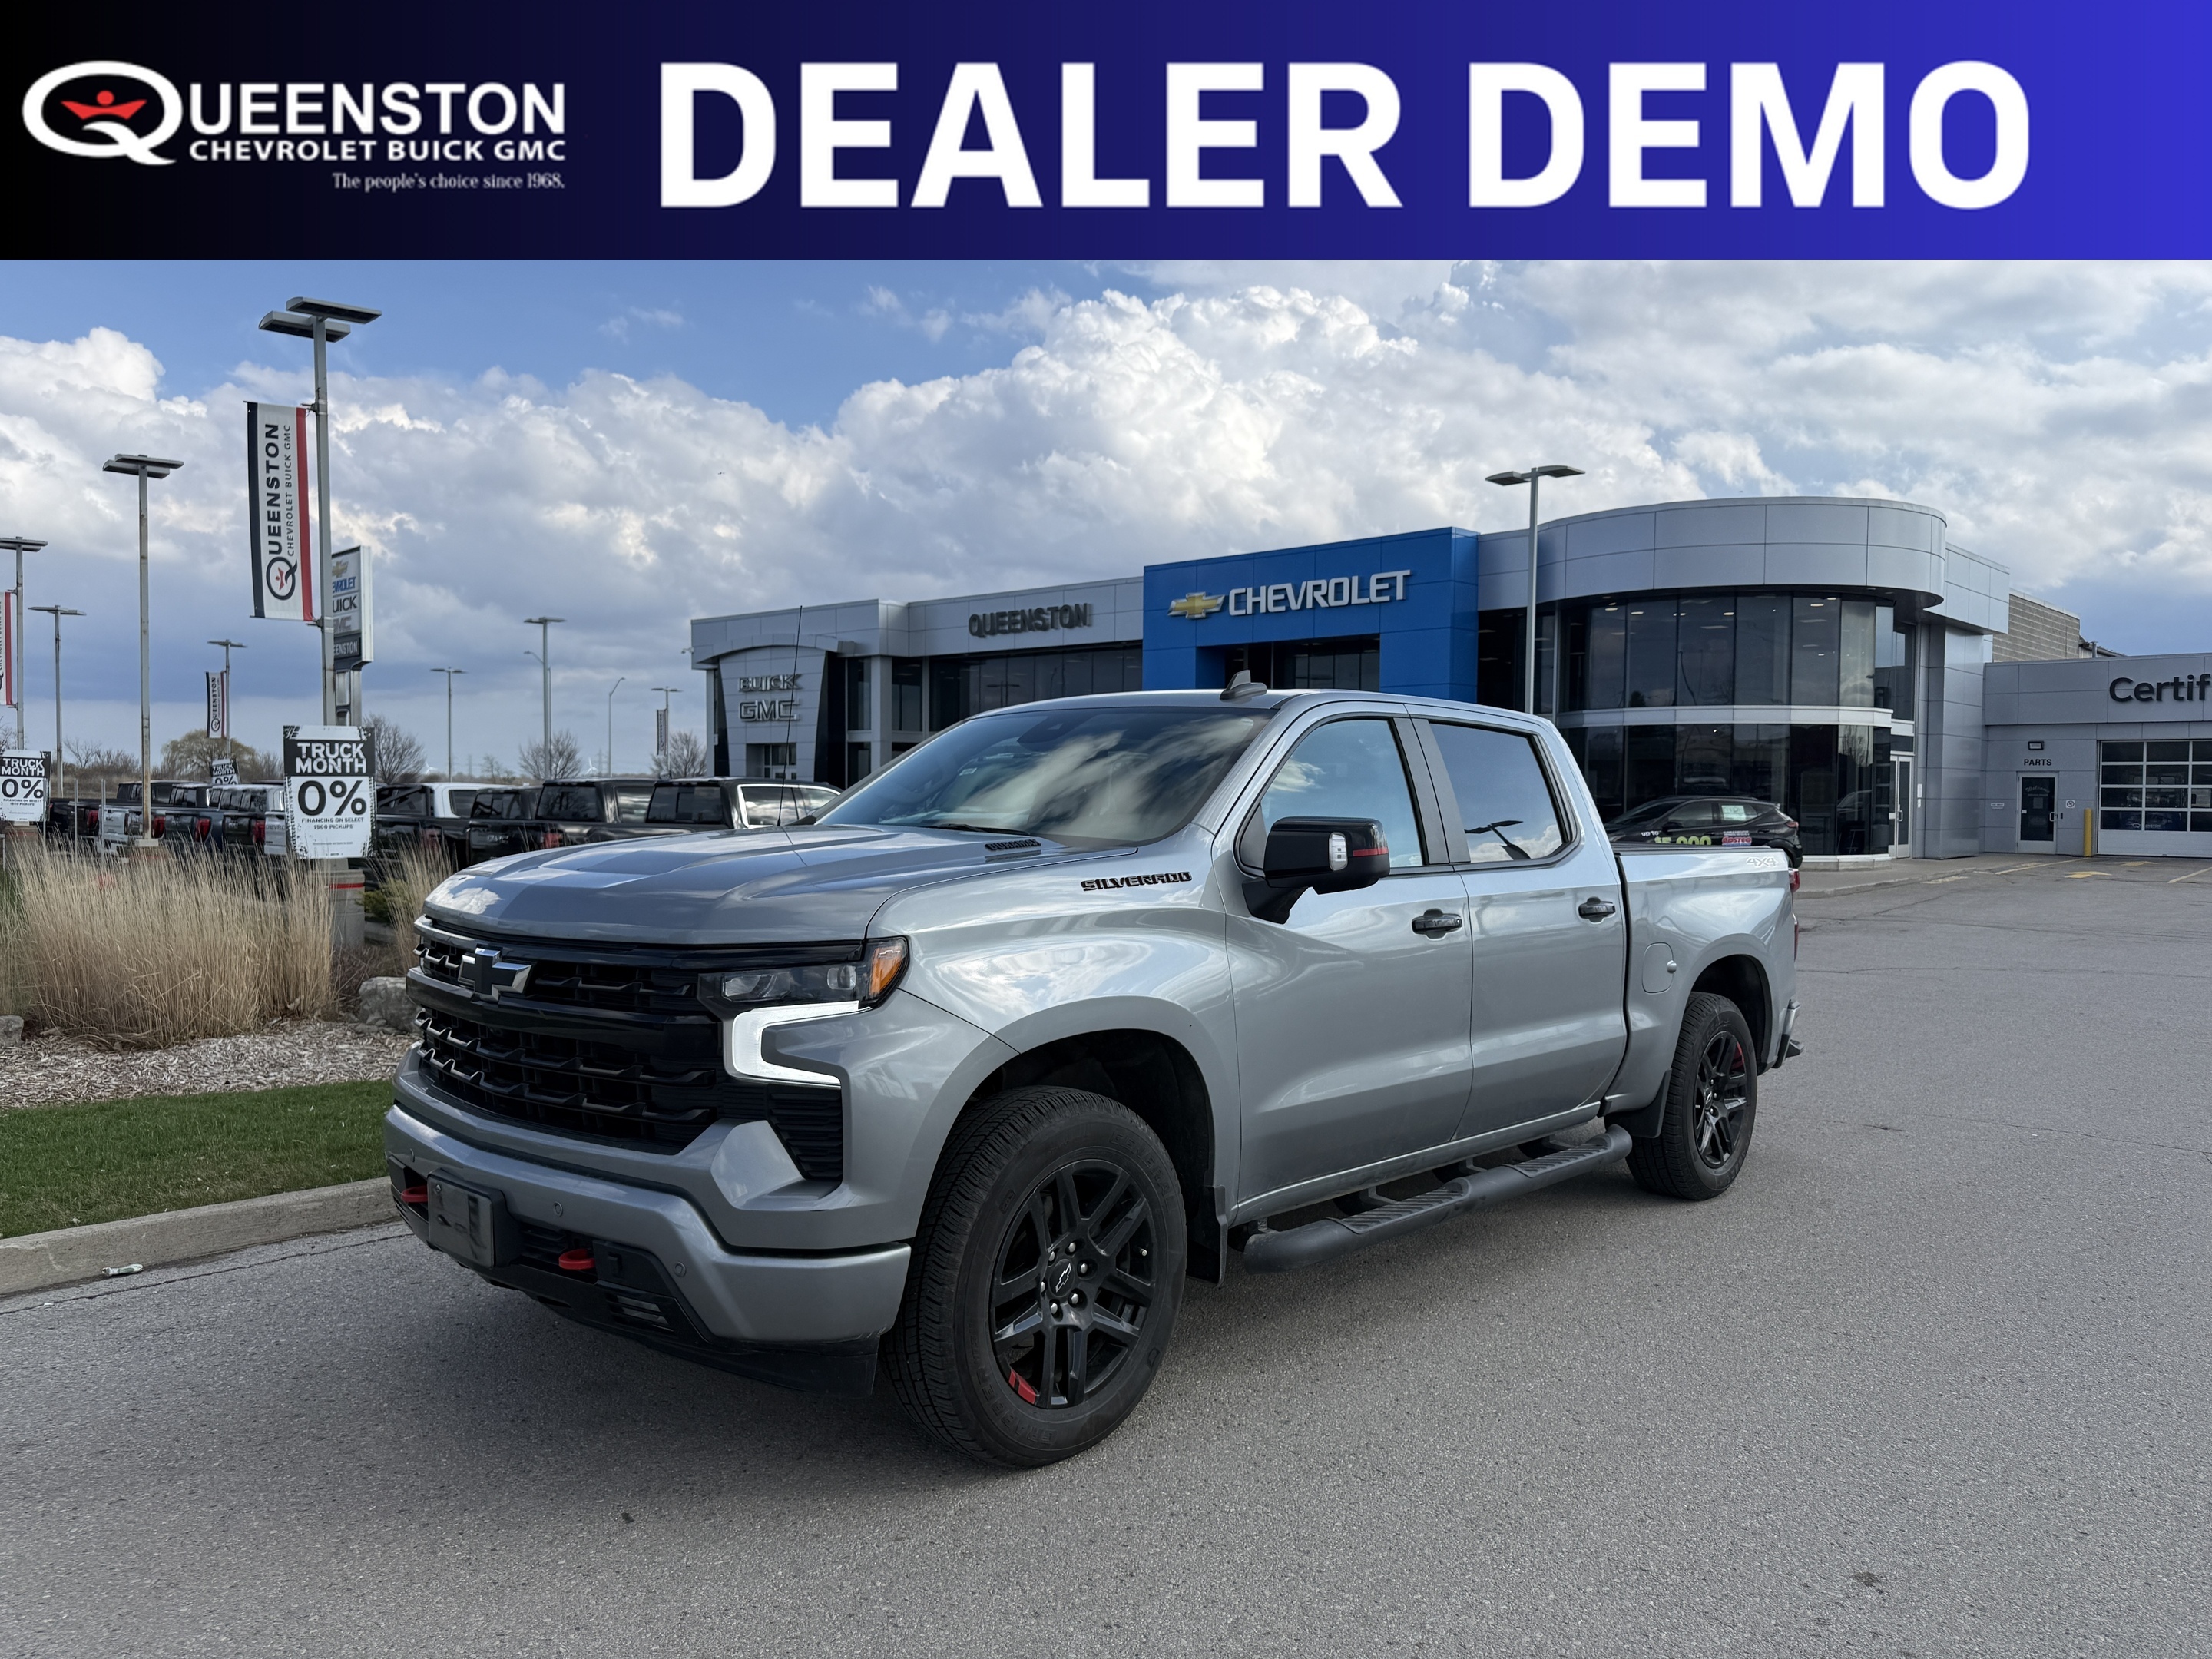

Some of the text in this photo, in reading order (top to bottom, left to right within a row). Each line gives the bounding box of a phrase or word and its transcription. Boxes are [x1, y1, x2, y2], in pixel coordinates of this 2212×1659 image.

[265, 423, 297, 600] QUEENSTON
[284, 492, 294, 556] CHEVROLET
[1229, 570, 1410, 615] CHEVROLET
[333, 595, 357, 613] UICK
[969, 603, 1093, 638] QUEENSTON
[739, 674, 803, 692] BUICK
[740, 699, 801, 722] GMC
[297, 742, 365, 759] TRUCK
[1, 766, 45, 777] MONTH
[2, 757, 45, 769] TRUCK
[296, 757, 367, 773] MONTH
[2023, 758, 2052, 767] PARTS
[2, 778, 44, 799] 0%
[215, 776, 237, 785] 0%
[298, 780, 367, 816] 0%
[985, 839, 1041, 851] DURAMAX
[1081, 872, 1193, 892] SILVERADO
